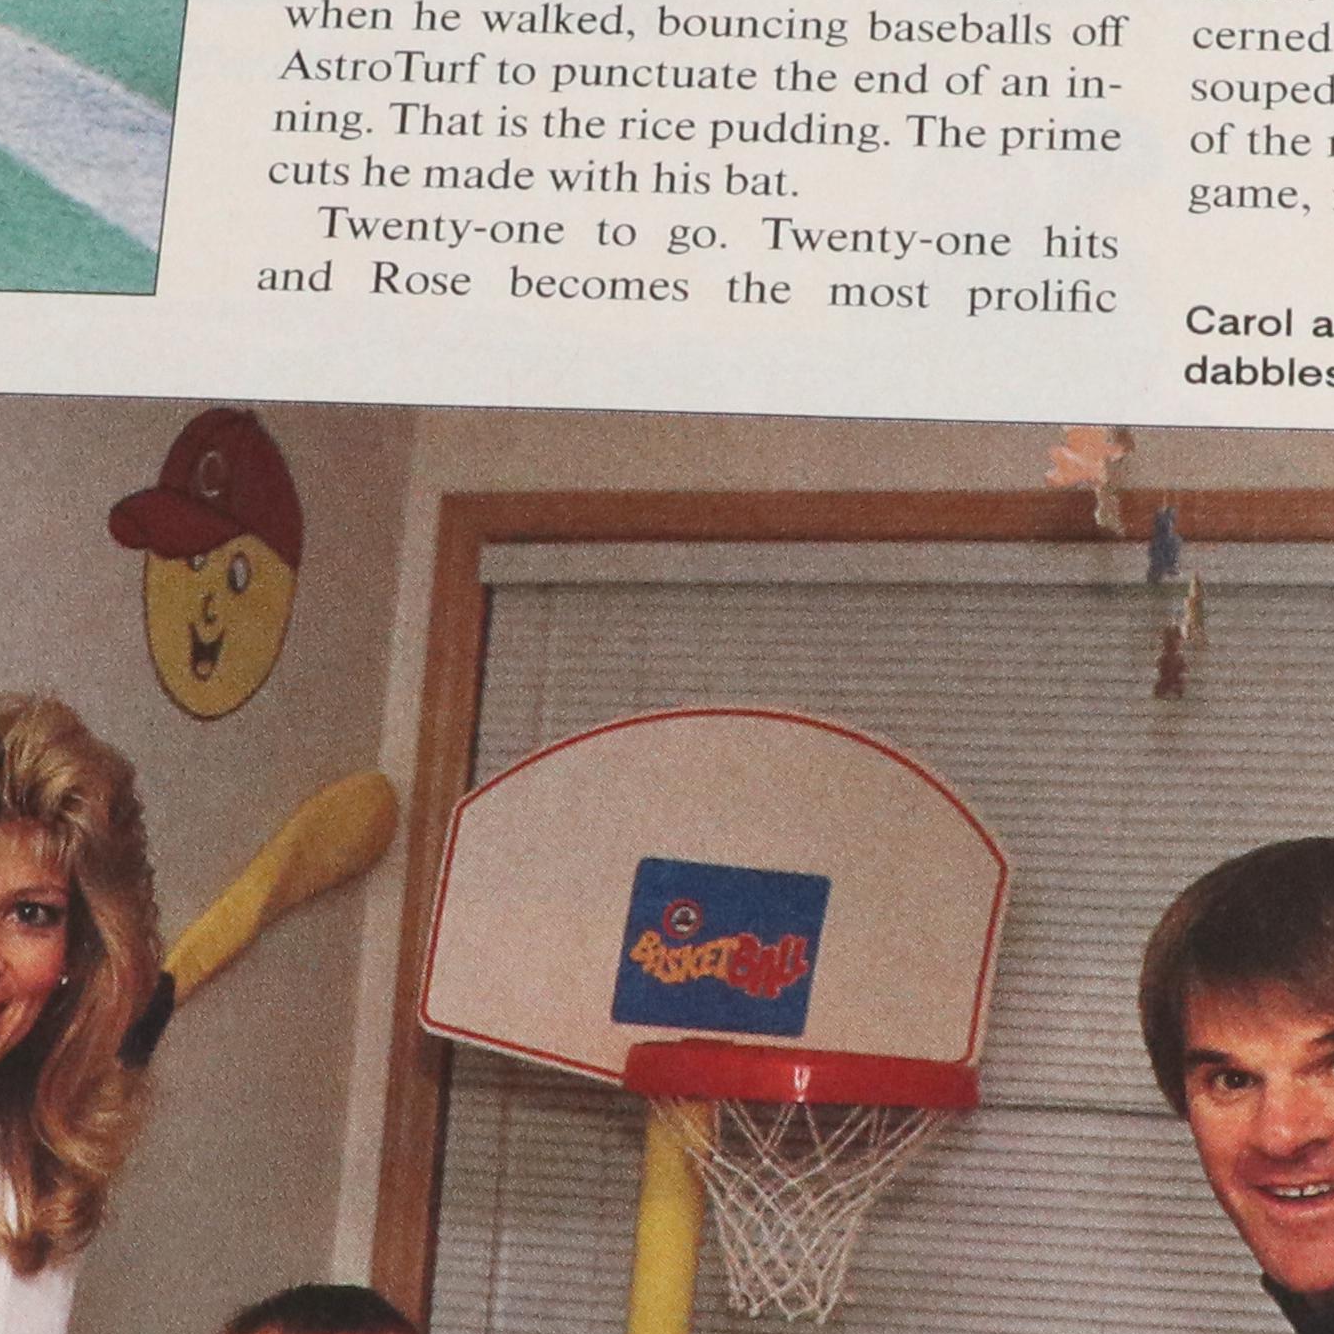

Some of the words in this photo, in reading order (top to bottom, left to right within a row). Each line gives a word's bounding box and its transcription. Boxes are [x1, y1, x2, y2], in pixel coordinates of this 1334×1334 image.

[317, 205, 565, 250] Twenty-one
[596, 218, 637, 247] to
[666, 224, 727, 256] go.
[761, 216, 1012, 261] Twenty-one
[1044, 224, 1119, 260] hits
[1185, 304, 1293, 338] Carol
